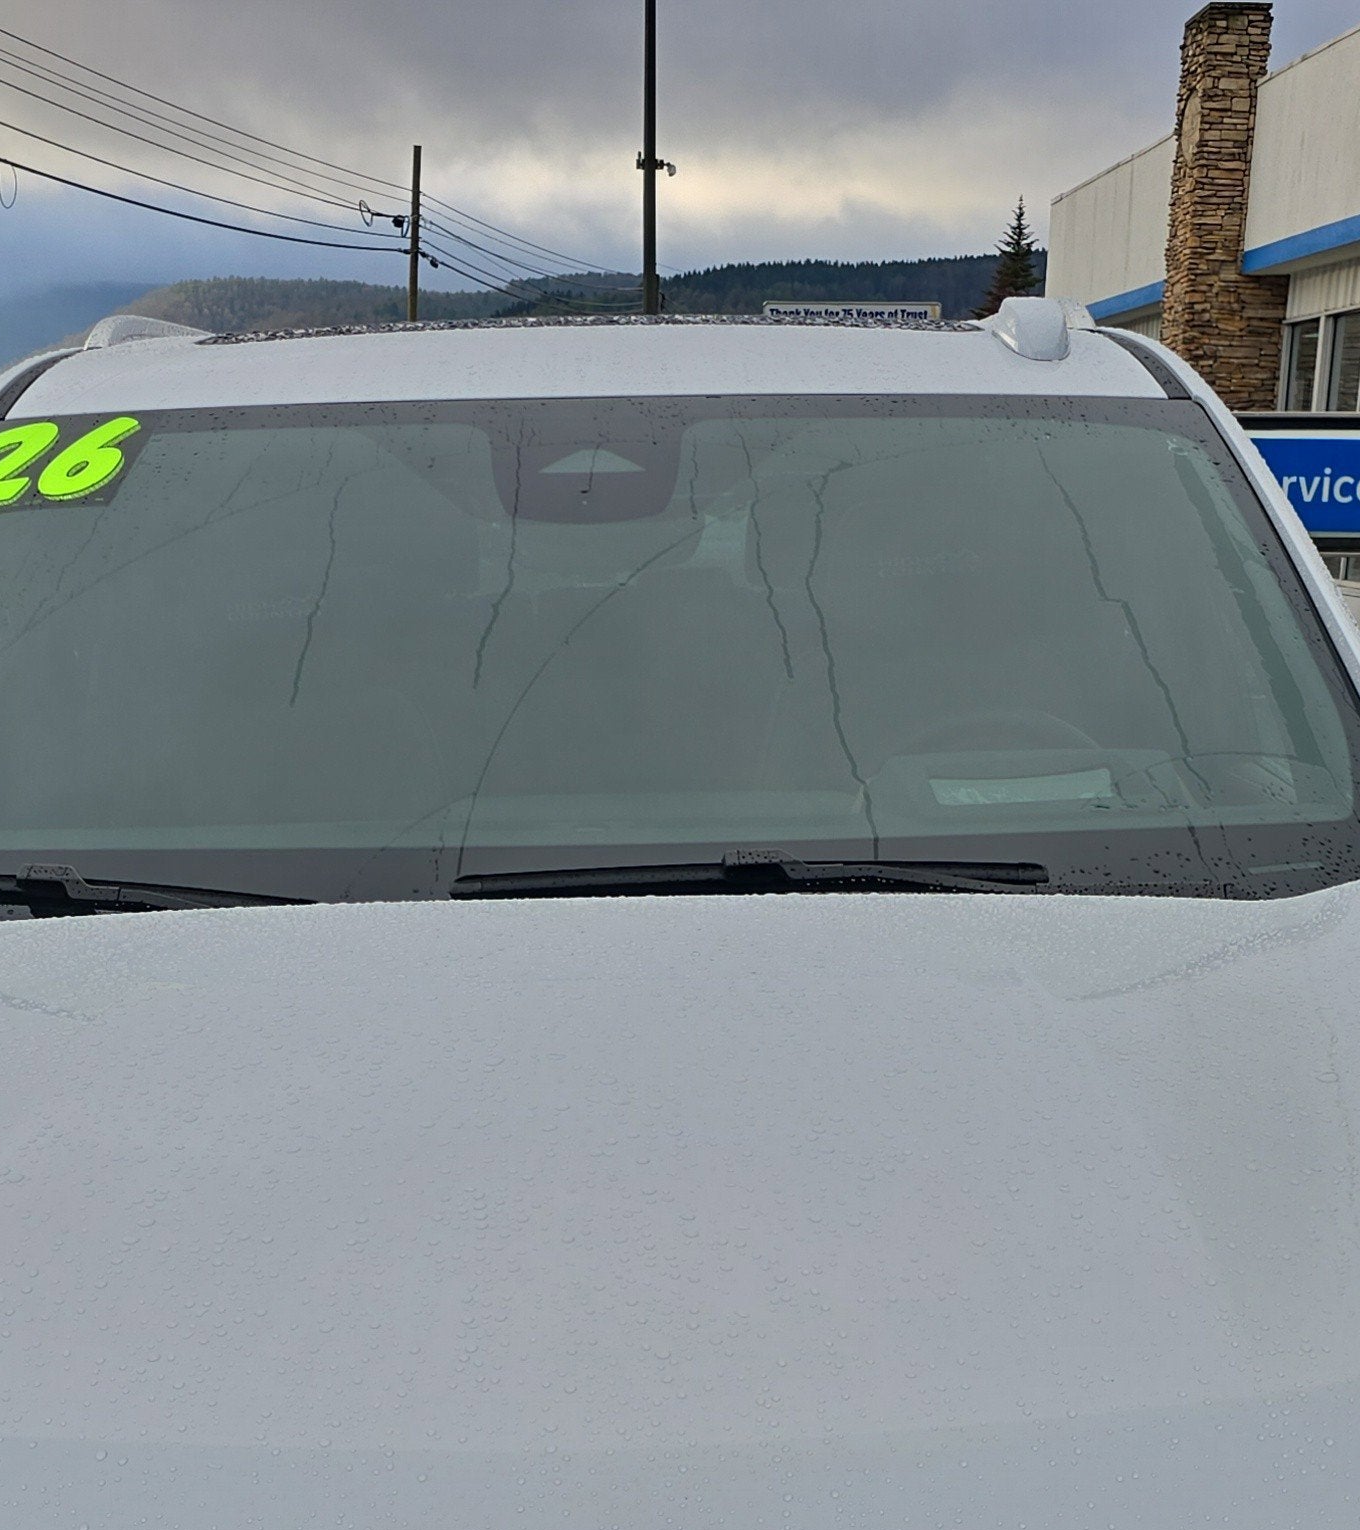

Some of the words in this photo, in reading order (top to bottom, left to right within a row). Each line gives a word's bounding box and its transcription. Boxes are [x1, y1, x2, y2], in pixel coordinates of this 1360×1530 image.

[803, 308, 823, 317] You
[824, 308, 840, 318] for
[841, 308, 854, 318] 75
[900, 309, 928, 320] Trust
